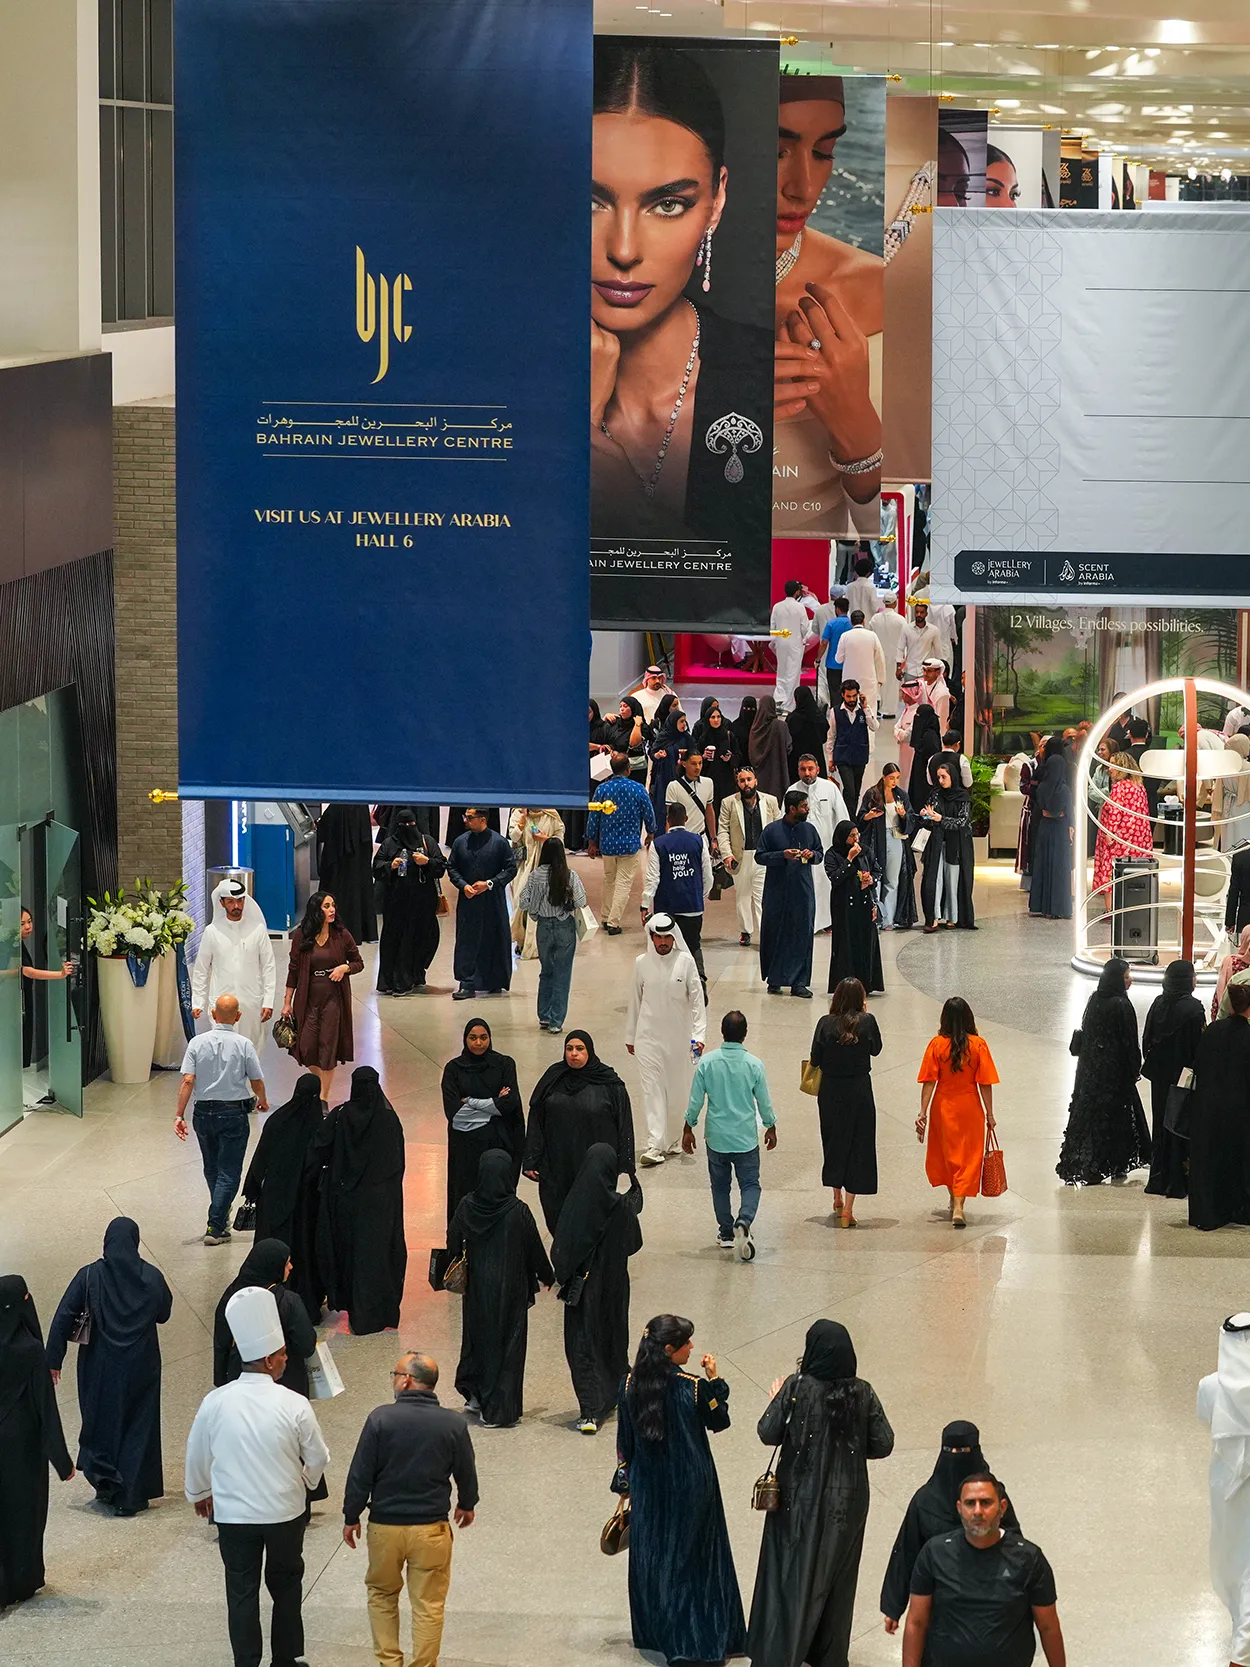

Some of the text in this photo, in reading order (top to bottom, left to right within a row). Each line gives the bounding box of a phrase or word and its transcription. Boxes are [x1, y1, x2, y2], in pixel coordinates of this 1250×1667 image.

[356, 245, 414, 385] bjc
[256, 433, 514, 449] BAHRAIN JEWELLERY CENTRE
[773, 466, 800, 479] AIN
[772, 501, 822, 512] AND C10
[254, 509, 512, 528] VISIT US AT JEWELLERY ARABIA
[356, 534, 414, 548] HALL 6
[610, 560, 680, 570] JEWELLERY
[684, 561, 732, 572] CENTRE
[1078, 563, 1110, 572] SCENT
[1078, 572, 1114, 580] ARABIA
[1010, 615, 1204, 635] 12 Villages. Endless possibilities.
[668, 853, 688, 862] How
[672, 868, 695, 880] you?
